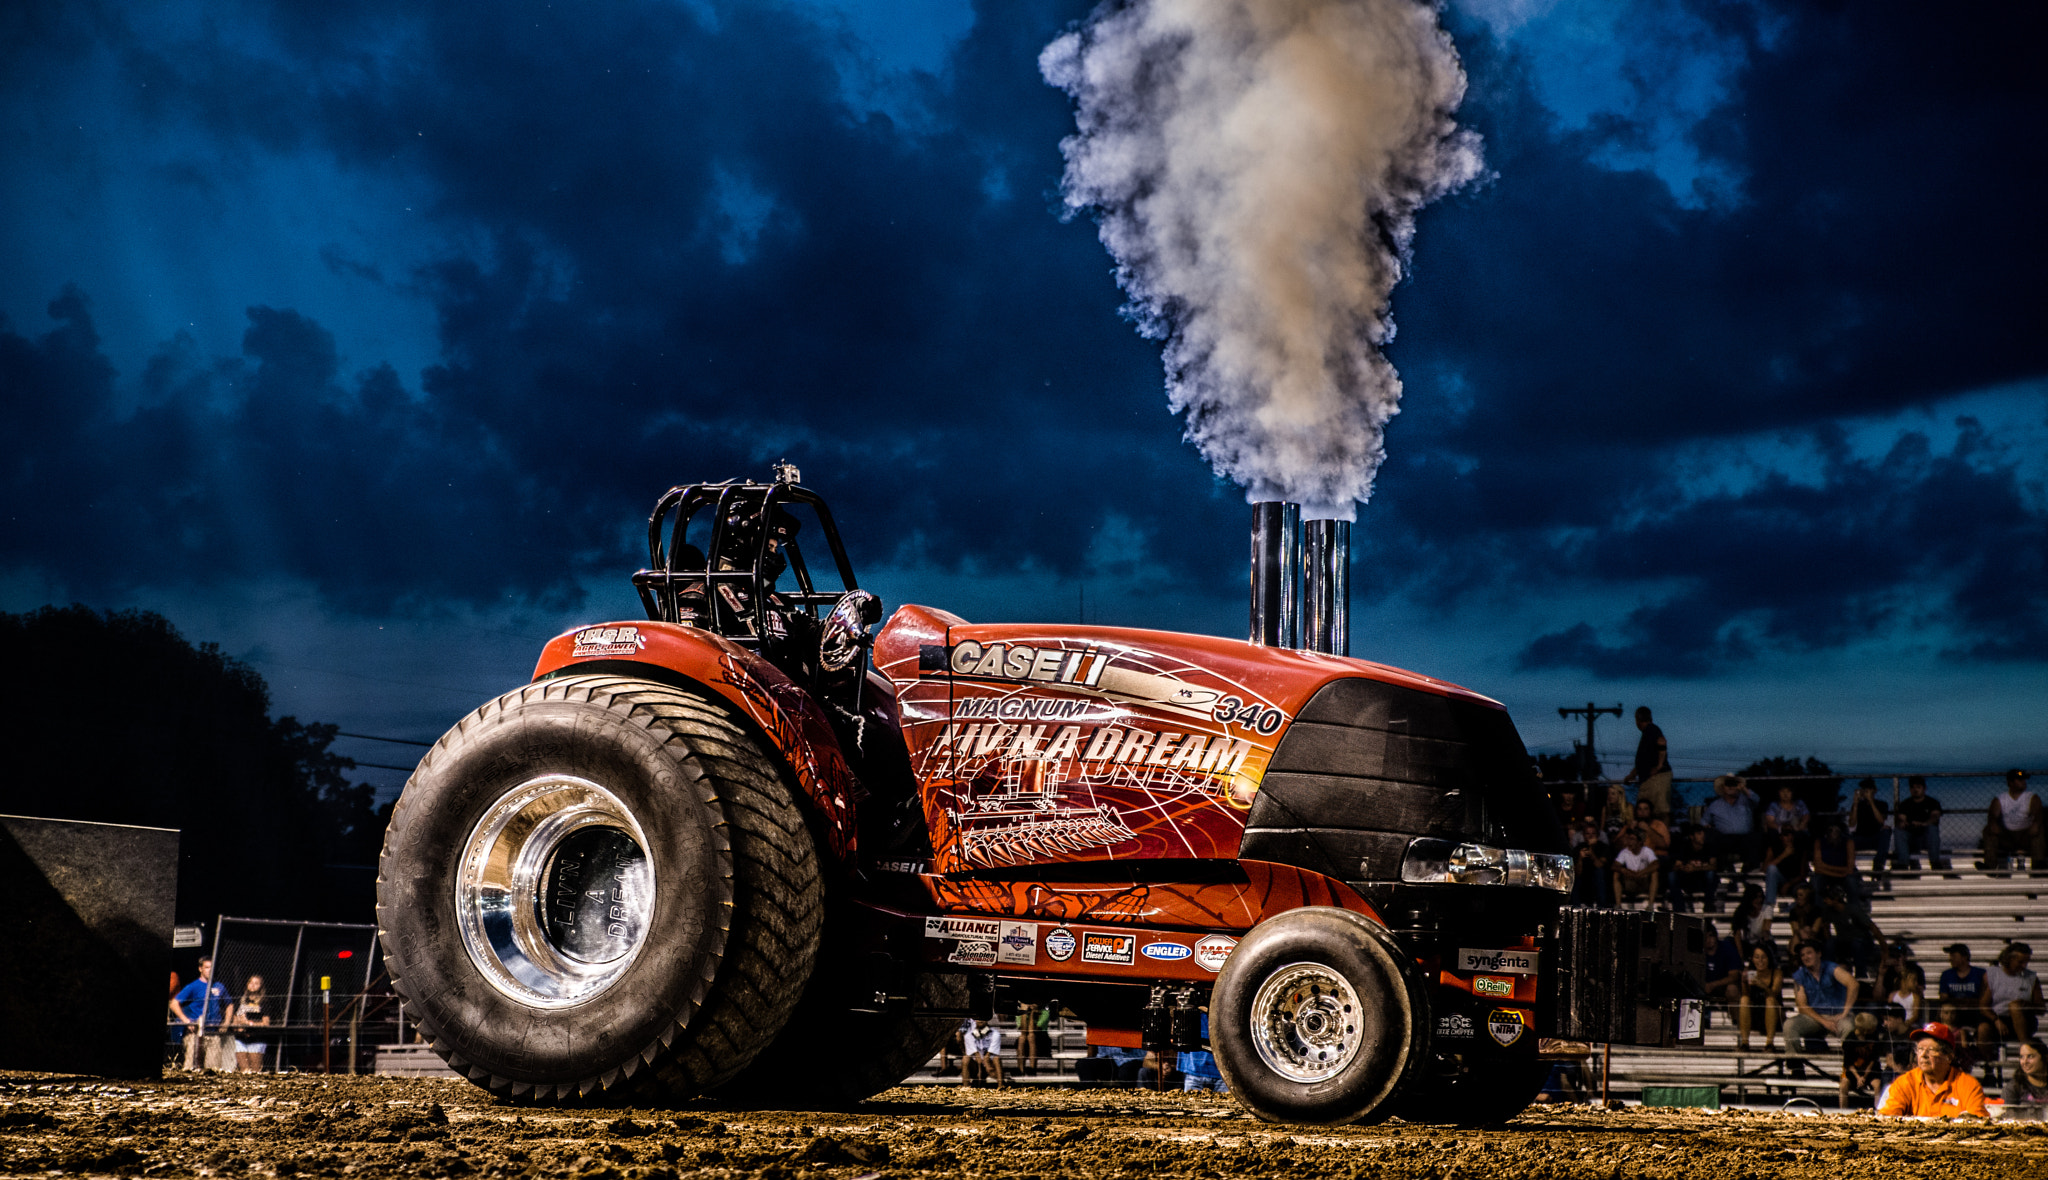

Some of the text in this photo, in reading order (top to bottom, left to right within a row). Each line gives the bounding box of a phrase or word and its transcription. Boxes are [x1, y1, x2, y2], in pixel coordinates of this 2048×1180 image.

[583, 627, 638, 643] H&R
[955, 697, 1088, 721] MAGNUM
[1214, 696, 1284, 735] 340
[1043, 725, 1081, 759] A
[1082, 728, 1252, 773] DREAM
[585, 889, 605, 904] A
[608, 853, 636, 939] DREAM
[938, 920, 999, 935] ALLIANCE
[1085, 943, 1113, 953] SERVICE
[1087, 936, 1113, 946] POWER
[1085, 951, 1131, 962] Diesel Additives
[1146, 946, 1187, 957] ENGLER
[1467, 953, 1530, 971] syngenta
[1476, 978, 1511, 994] O'Reilly
[1496, 1024, 1516, 1035] NTPA
